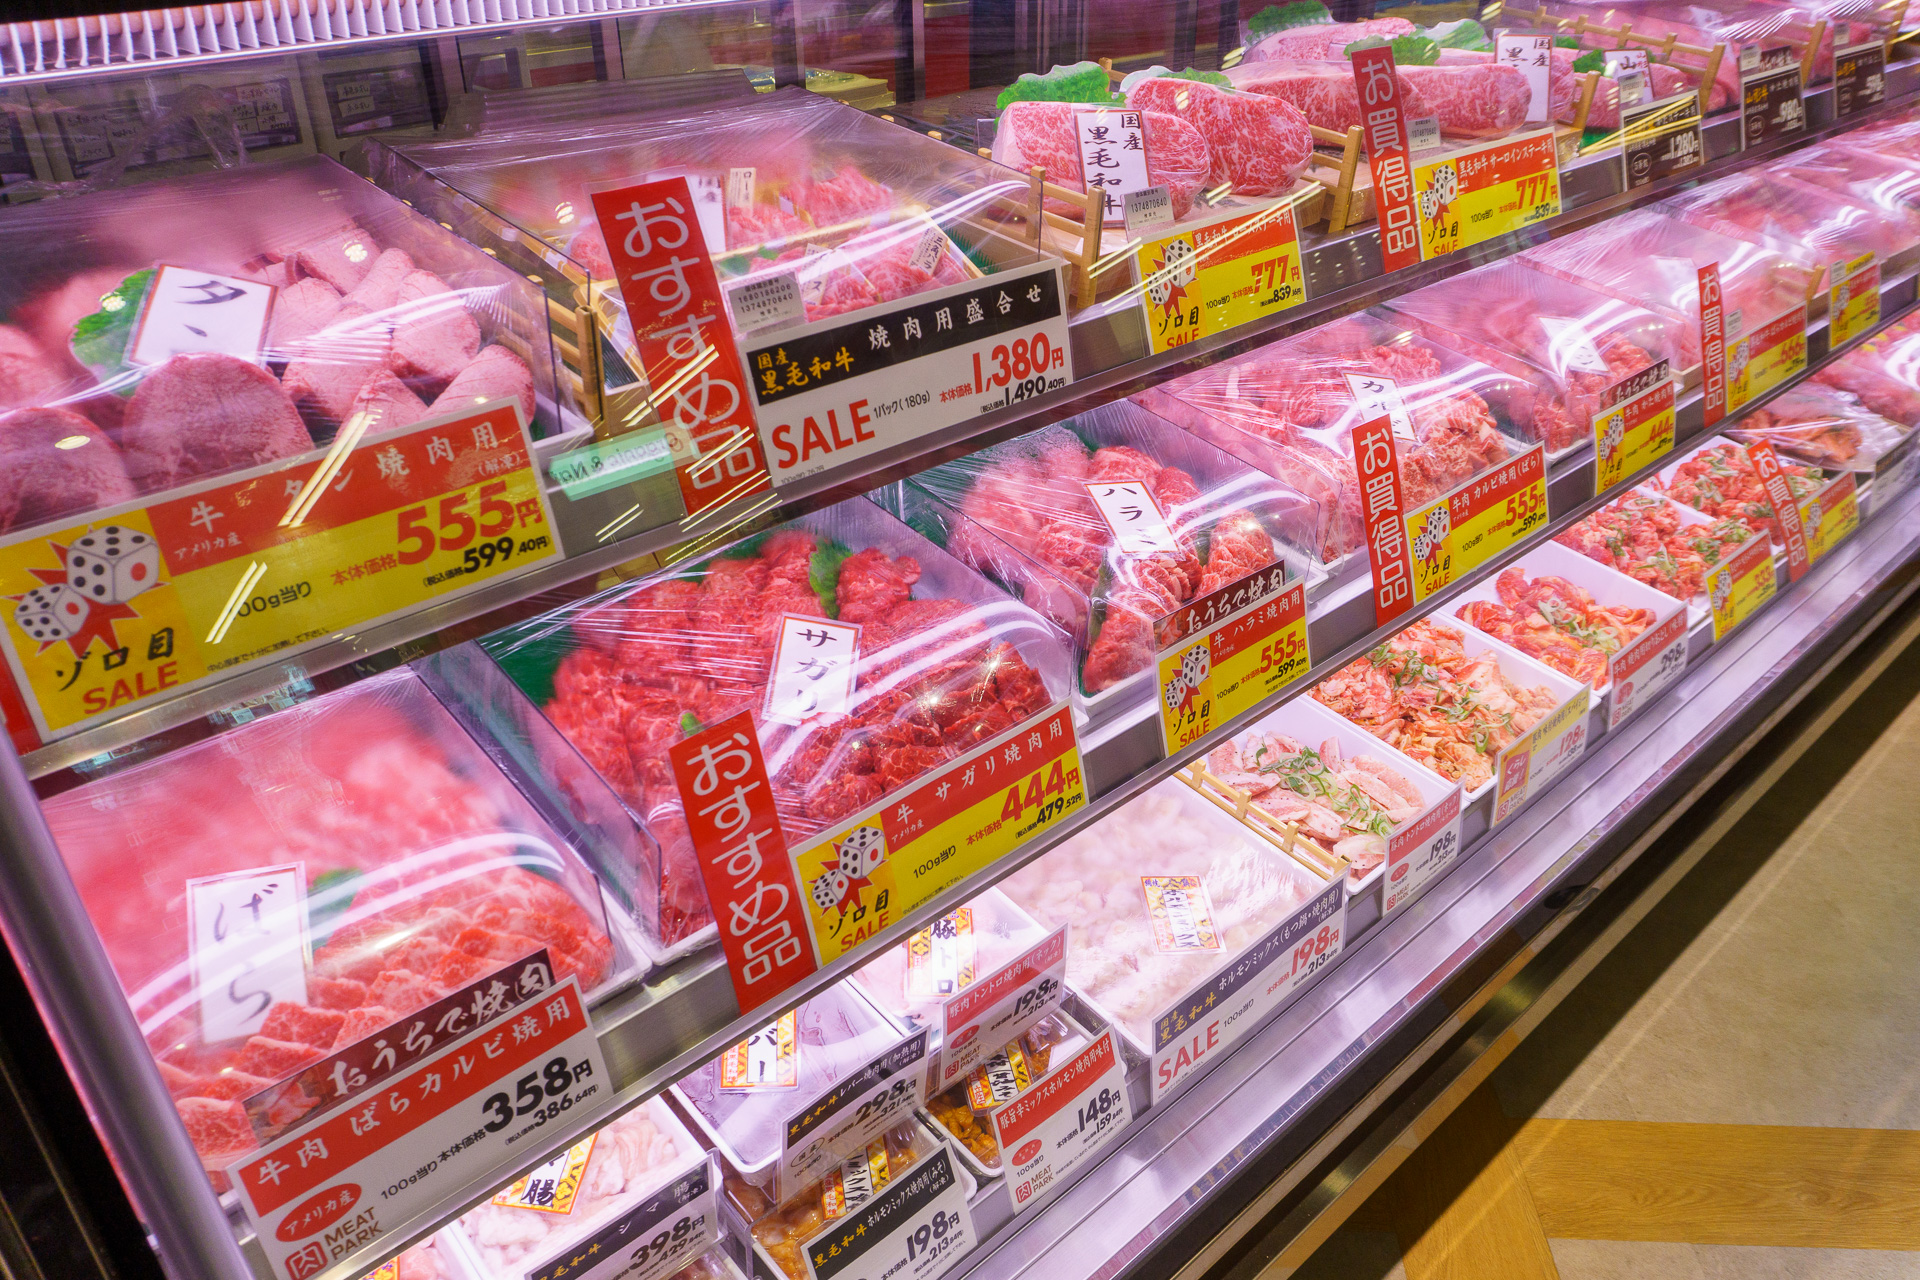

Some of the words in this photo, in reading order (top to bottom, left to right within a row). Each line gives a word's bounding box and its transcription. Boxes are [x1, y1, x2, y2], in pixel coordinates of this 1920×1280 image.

[1501, 48, 1528, 70] 黒
[1120, 113, 1143, 150] 国産
[1361, 58, 1416, 254] お買得品
[1084, 126, 1122, 216] 黒毛和牛
[1459, 154, 1488, 179] 黒毛和牛
[1490, 138, 1554, 169] サーロインステーキ用
[1516, 172, 1558, 210] 777円
[1428, 221, 1458, 245] ゾロ目
[1206, 295, 1230, 310] 100g当り
[1251, 254, 1301, 294] 777円
[615, 196, 756, 490] おすすめ品
[761, 346, 855, 396] 黒毛和牛
[869, 284, 1042, 350] 焼肉用盛合せ
[1159, 306, 1199, 336] ゾロ目
[1167, 328, 1199, 350] SALE
[1701, 271, 1723, 410] お買得品
[757, 348, 790, 369] 国産
[940, 382, 973, 404] 本体価格
[972, 332, 1064, 395] 1,380円
[771, 398, 875, 470] SALE
[478, 451, 521, 477] (解凍)
[1452, 493, 1470, 512] 牛肉
[1474, 453, 1540, 499] カルビ焼用(ばら)
[190, 501, 224, 534] 牛
[1360, 427, 1408, 608] お買得品
[1462, 533, 1483, 552] 100g当り
[1506, 484, 1545, 526] 555円
[1754, 448, 1806, 567] お買得品
[174, 532, 242, 561] アメリカ産
[231, 581, 311, 620] 00g当り
[330, 552, 398, 586] 本体価格
[397, 481, 543, 565] 555円
[1421, 555, 1450, 584] ゾロ目
[1186, 569, 1283, 635] おうちで焼肉
[1426, 573, 1450, 596] SALE
[1213, 632, 1226, 648] 牛
[1234, 589, 1301, 637] ハラミ焼肉用
[56, 627, 174, 692] ゾロ目
[1216, 682, 1239, 700] 100g当り
[1260, 631, 1306, 674] 555円
[83, 661, 179, 714] SALE
[1173, 699, 1210, 735] ゾロ目
[1179, 718, 1210, 748] SALE
[896, 803, 914, 825] 牛
[935, 717, 1063, 802] サガリ焼肉用
[891, 818, 925, 844] アメリカ産
[913, 845, 956, 879] 100g当り
[966, 819, 1003, 847] 本体価格
[1000, 758, 1080, 823] 444円
[686, 732, 801, 985] おすすめ品
[1429, 831, 1456, 861] 198円
[829, 888, 889, 940] ゾロ目
[840, 910, 890, 953] SALE
[1013, 978, 1059, 1017] 198円
[1223, 998, 1254, 1028] 100g当り
[1266, 971, 1290, 996] 本体価格
[1290, 925, 1340, 977] 198円
[327, 962, 551, 1098] おうちで焼肉
[950, 998, 970, 1018] 豚肉
[1159, 992, 1216, 1046] 黒毛和牛
[1160, 1011, 1178, 1030] 国産
[960, 1044, 981, 1064] MEAT
[1158, 1020, 1220, 1090] SALE
[258, 1138, 329, 1187] 牛肉
[350, 996, 571, 1137] ばらカルビ焼用
[788, 1095, 838, 1138] 黒毛和牛
[855, 1078, 917, 1126] 298円
[381, 1160, 438, 1200] 100g当り
[437, 1128, 486, 1164] 本体価格
[482, 1057, 593, 1133] 358円
[1056, 1128, 1079, 1149] 本体価格
[1078, 1088, 1121, 1133] 148円
[929, 1174, 950, 1194] (解凍)
[1017, 1155, 1044, 1177] 100g当り
[1031, 1164, 1053, 1184] MEAT
[1033, 1172, 1054, 1193] PARK
[285, 1190, 354, 1236] アメリカ産
[324, 1206, 376, 1246] MEAT
[814, 1223, 867, 1269] 黒毛和牛
[867, 1159, 947, 1227] ホルモンミックス焼肉用(みそ)
[906, 1210, 960, 1262] 198円
[329, 1221, 383, 1262] PARK
[629, 1215, 706, 1271] 398円
